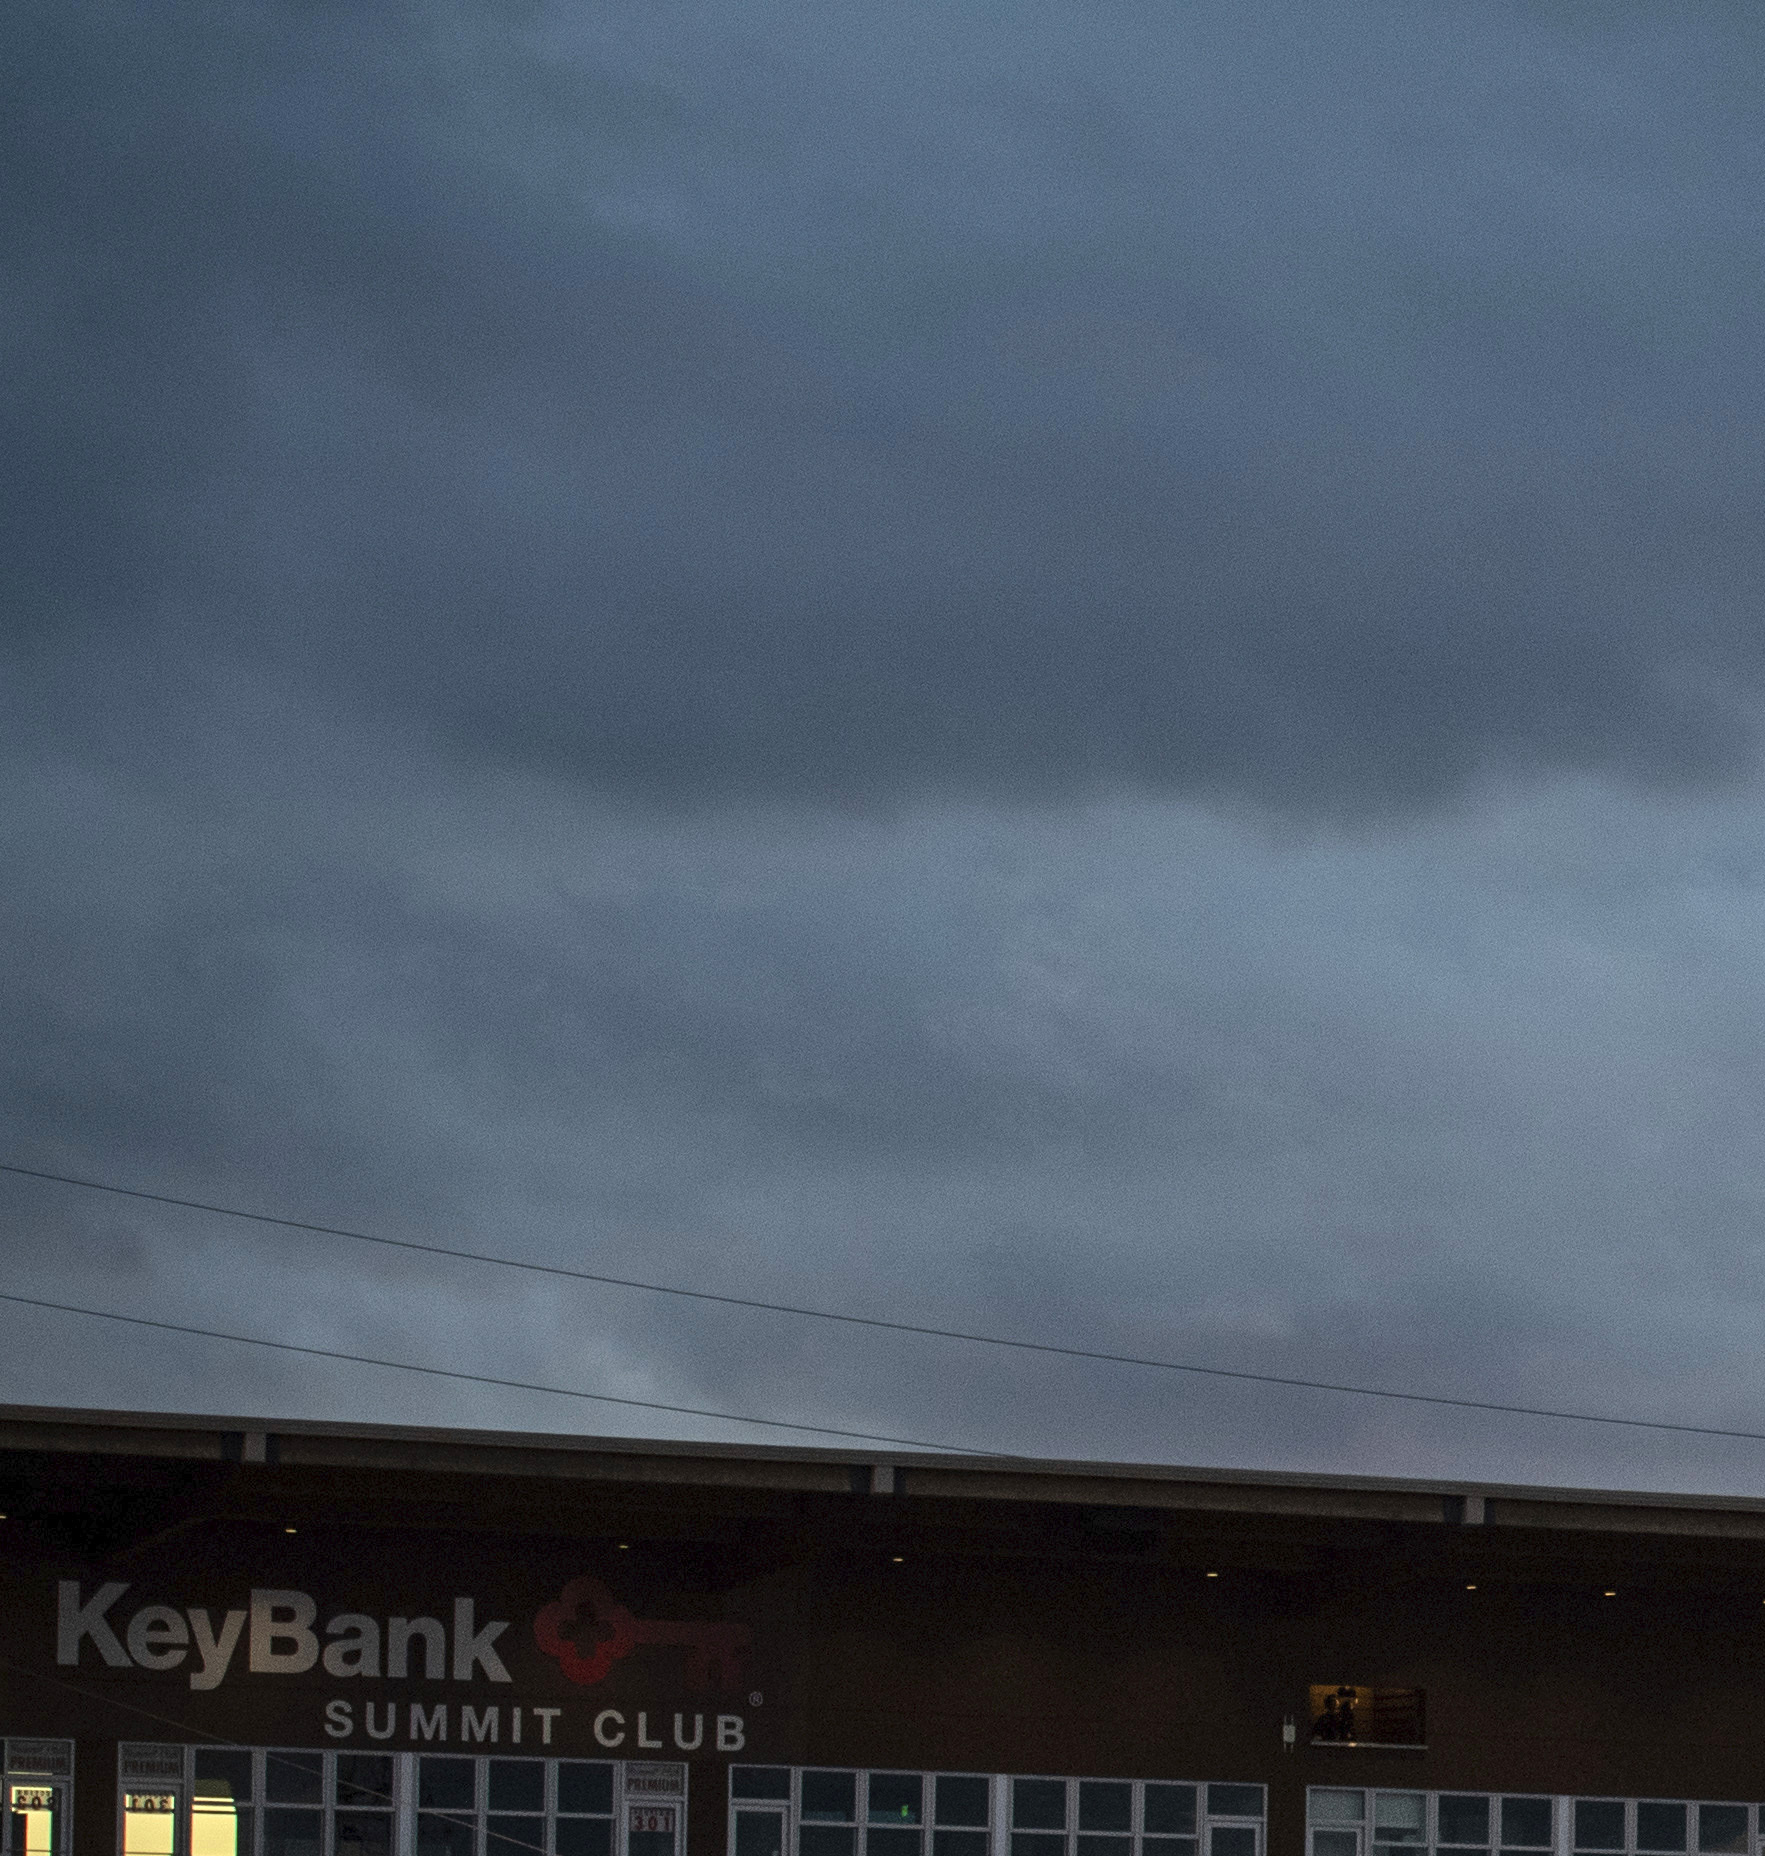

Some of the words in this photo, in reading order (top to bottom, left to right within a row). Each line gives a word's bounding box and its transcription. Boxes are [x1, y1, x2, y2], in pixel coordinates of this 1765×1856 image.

[56, 1579, 512, 1690] KeyBank
[324, 1700, 561, 1746] SUMMIT
[594, 1710, 746, 1752] CLUB
[634, 1815, 670, 1831] 301
